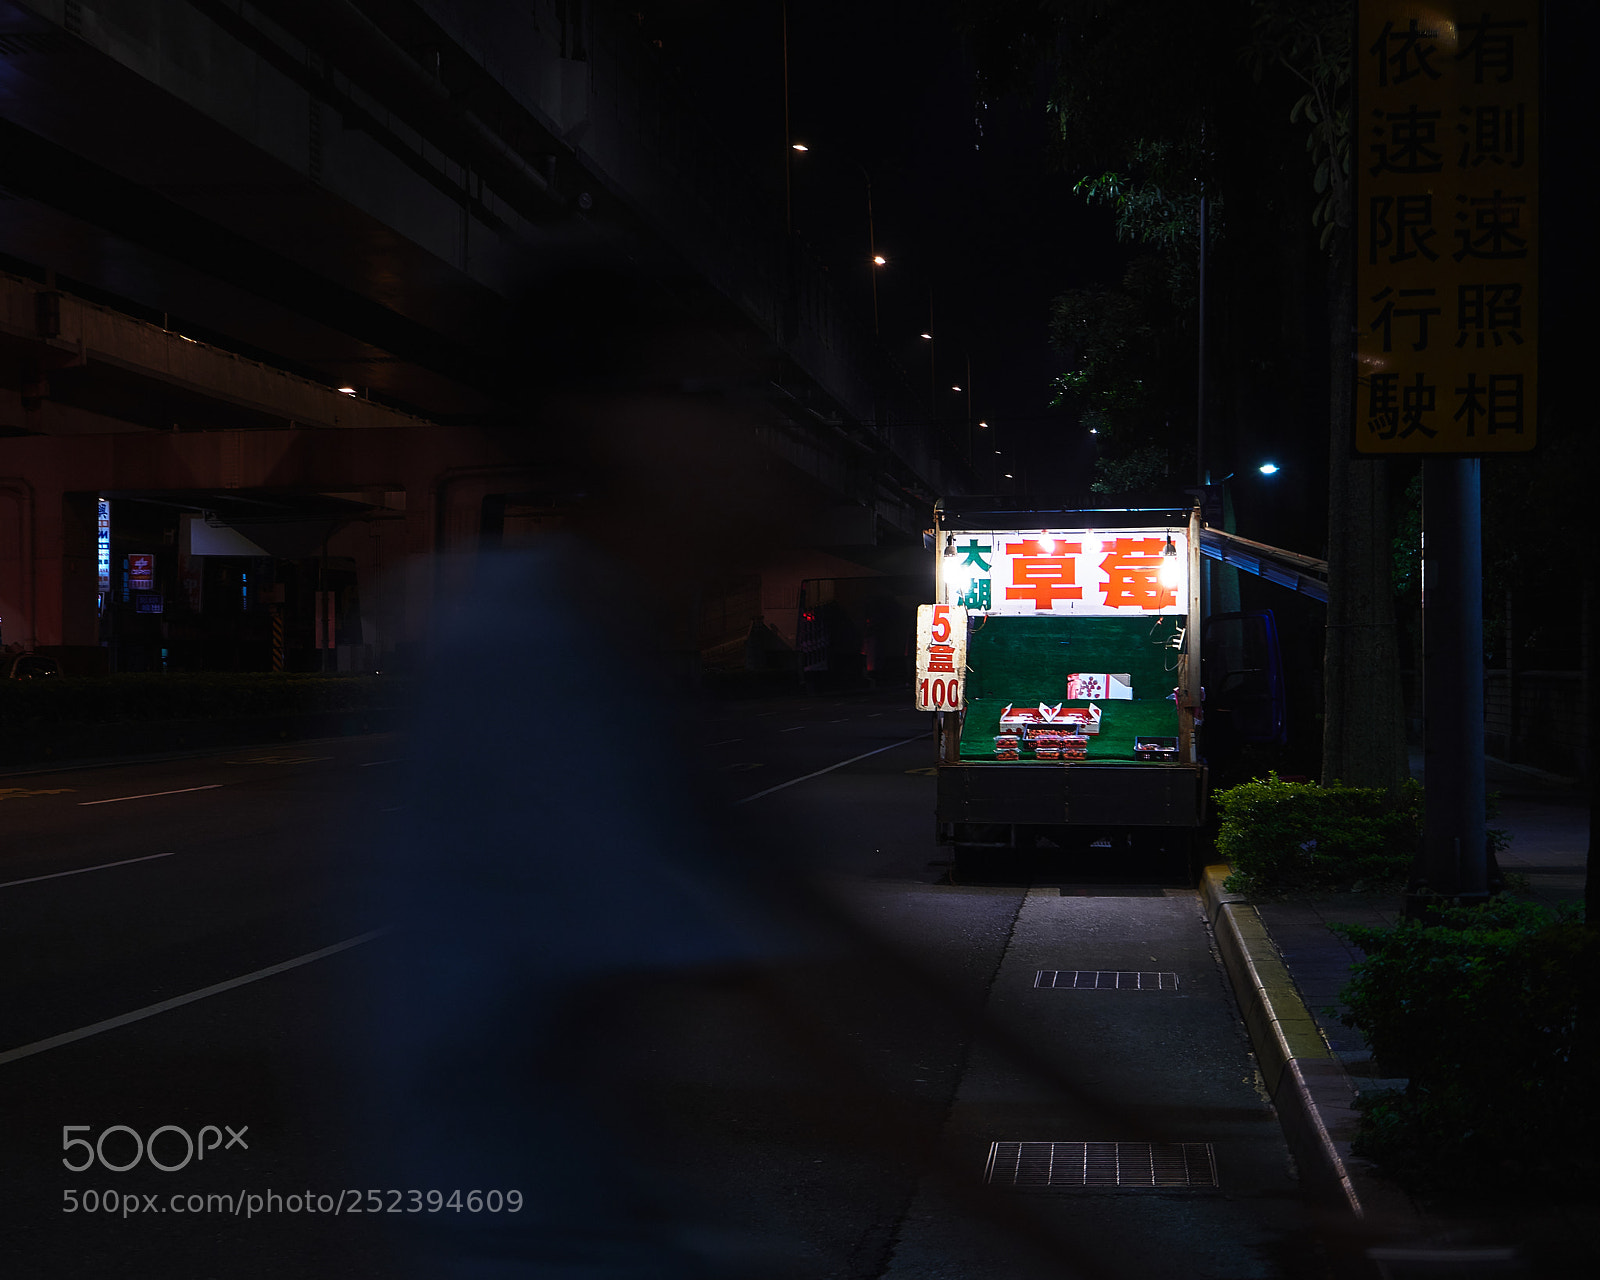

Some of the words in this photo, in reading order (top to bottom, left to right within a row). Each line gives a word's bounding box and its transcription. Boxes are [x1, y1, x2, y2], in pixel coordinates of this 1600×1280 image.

[1368, 19, 1442, 440] 依速限行駛
[1452, 13, 1528, 437] 有測速照相
[956, 538, 992, 611] 大湖
[1005, 537, 1179, 610] 草莓
[927, 645, 956, 673] 盒
[931, 605, 951, 643] 5
[920, 678, 959, 708] 100
